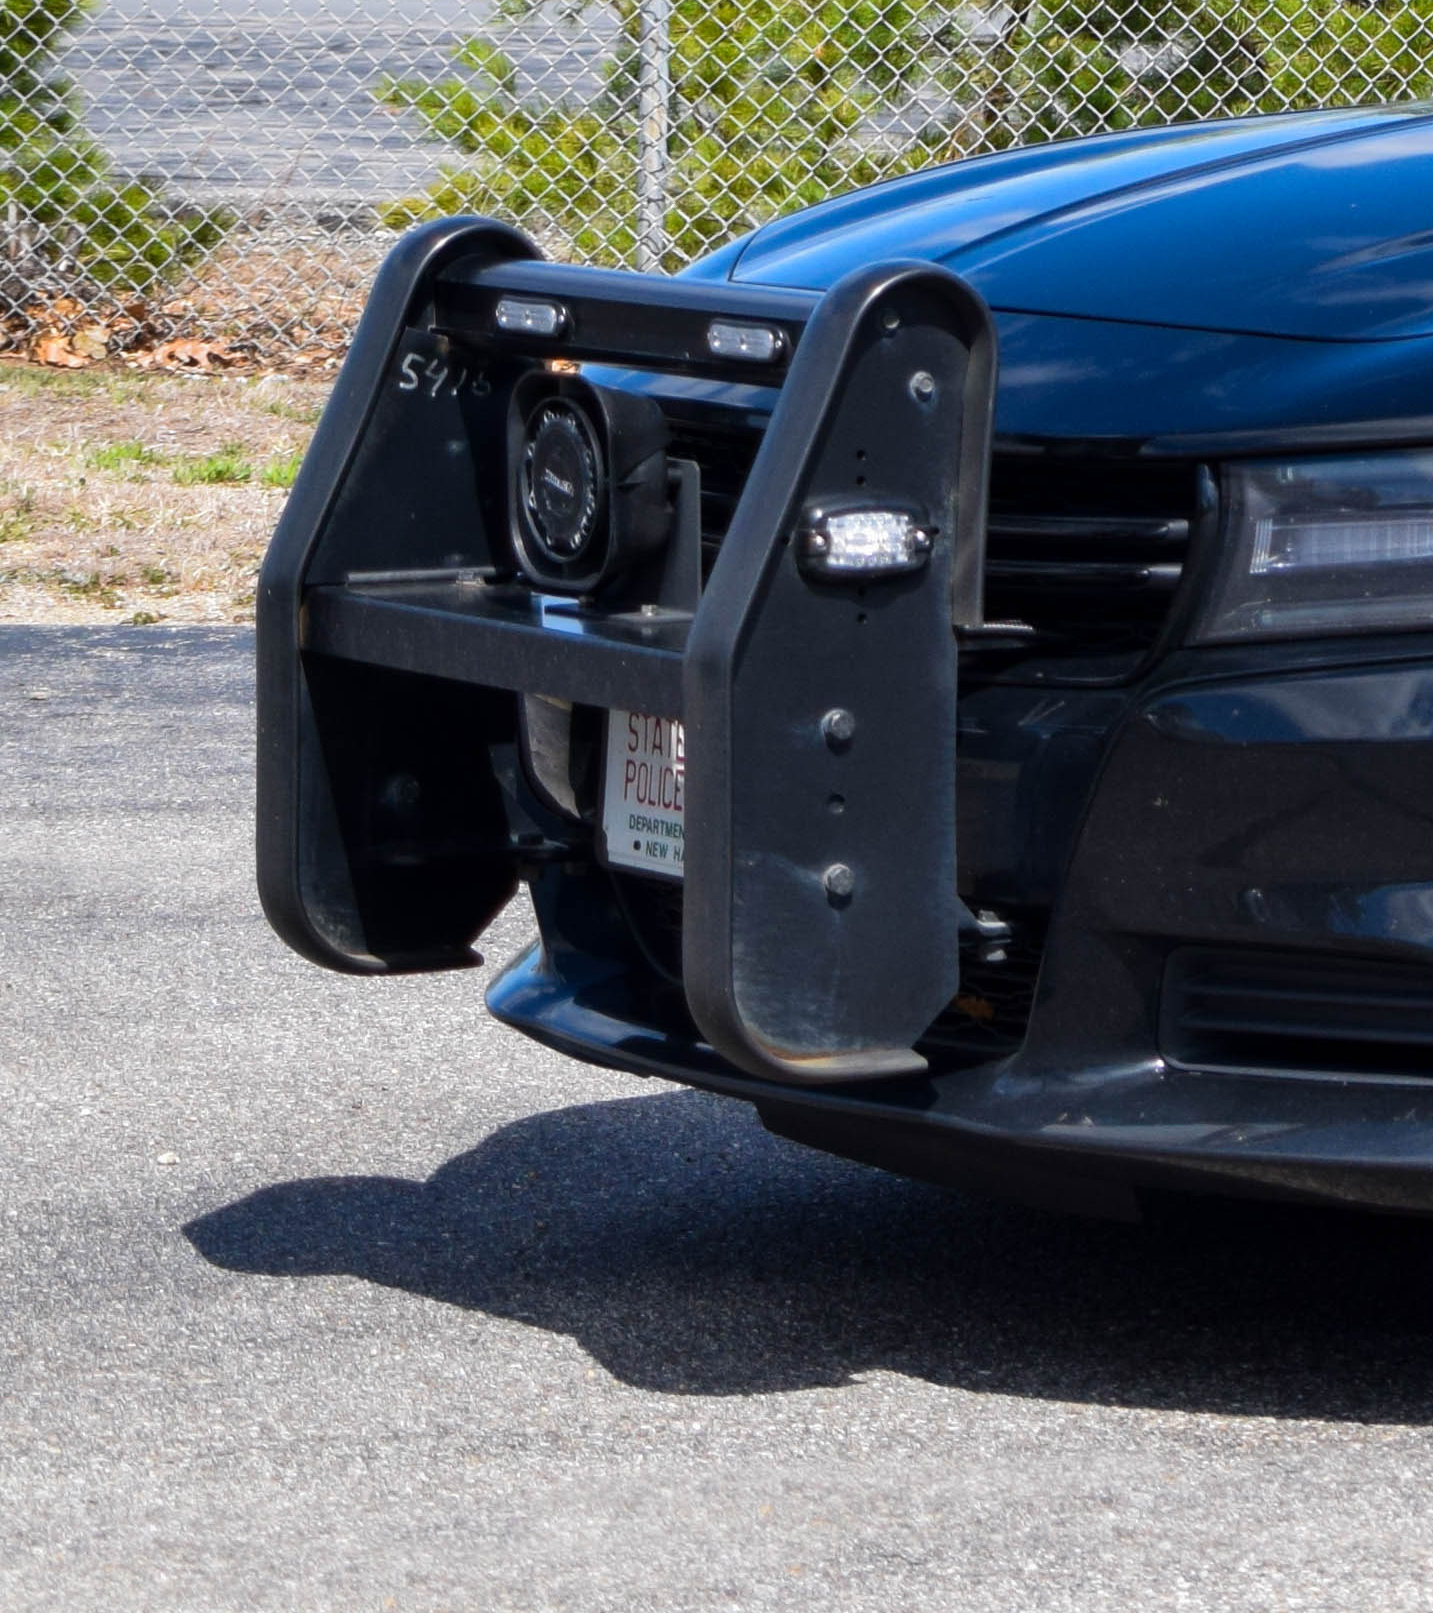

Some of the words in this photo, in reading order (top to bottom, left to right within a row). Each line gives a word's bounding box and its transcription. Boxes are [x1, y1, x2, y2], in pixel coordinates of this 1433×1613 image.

[628, 711, 686, 762] STATE
[624, 759, 686, 811] POLICE
[646, 841, 668, 861] NEW
